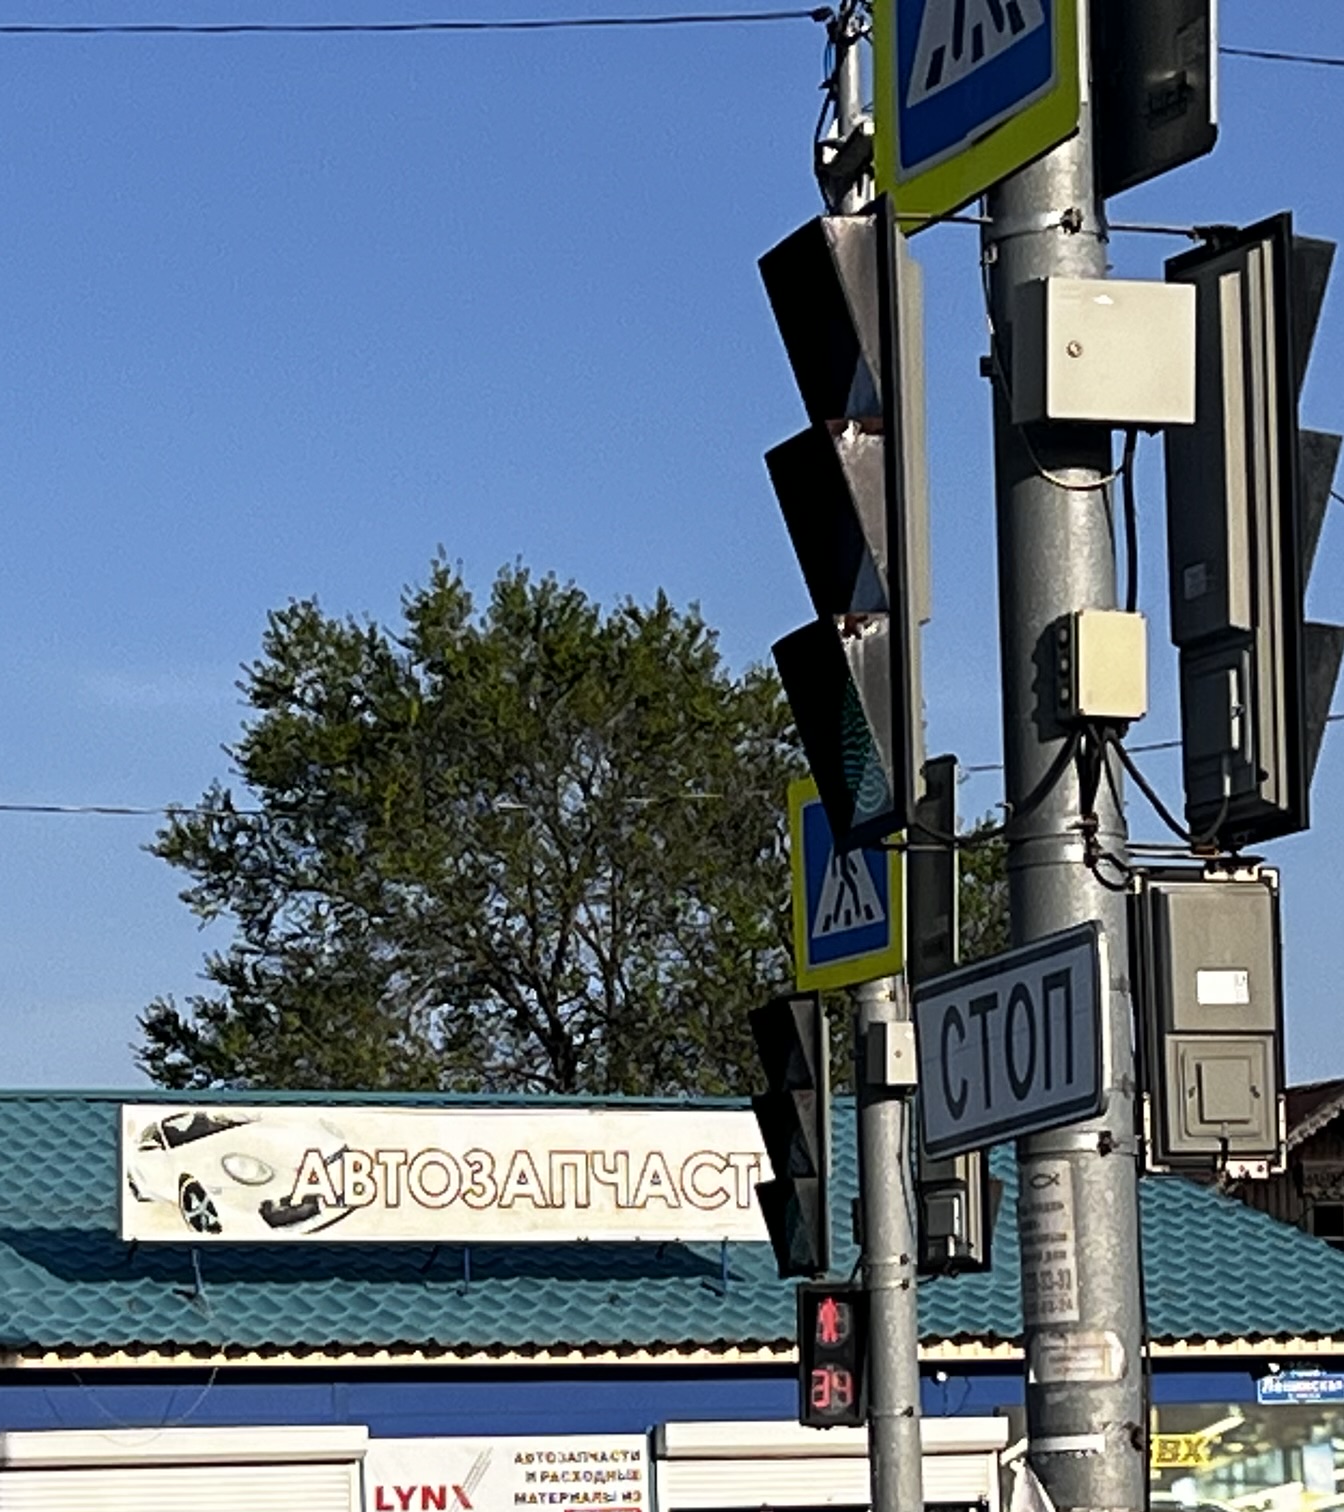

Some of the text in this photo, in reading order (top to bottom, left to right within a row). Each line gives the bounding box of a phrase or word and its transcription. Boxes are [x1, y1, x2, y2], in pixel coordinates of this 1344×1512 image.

[940, 967, 1074, 1120] СТОП
[291, 1148, 762, 1211] АВТОЗАПЧАСТ
[514, 1450, 641, 1465] АВТОЗАПЧАСТИ
[540, 1469, 641, 1484] РАСХОДНЫХ
[375, 1484, 474, 1512] LYNX
[514, 1491, 617, 1505] МАТЕРИАЛЫ
